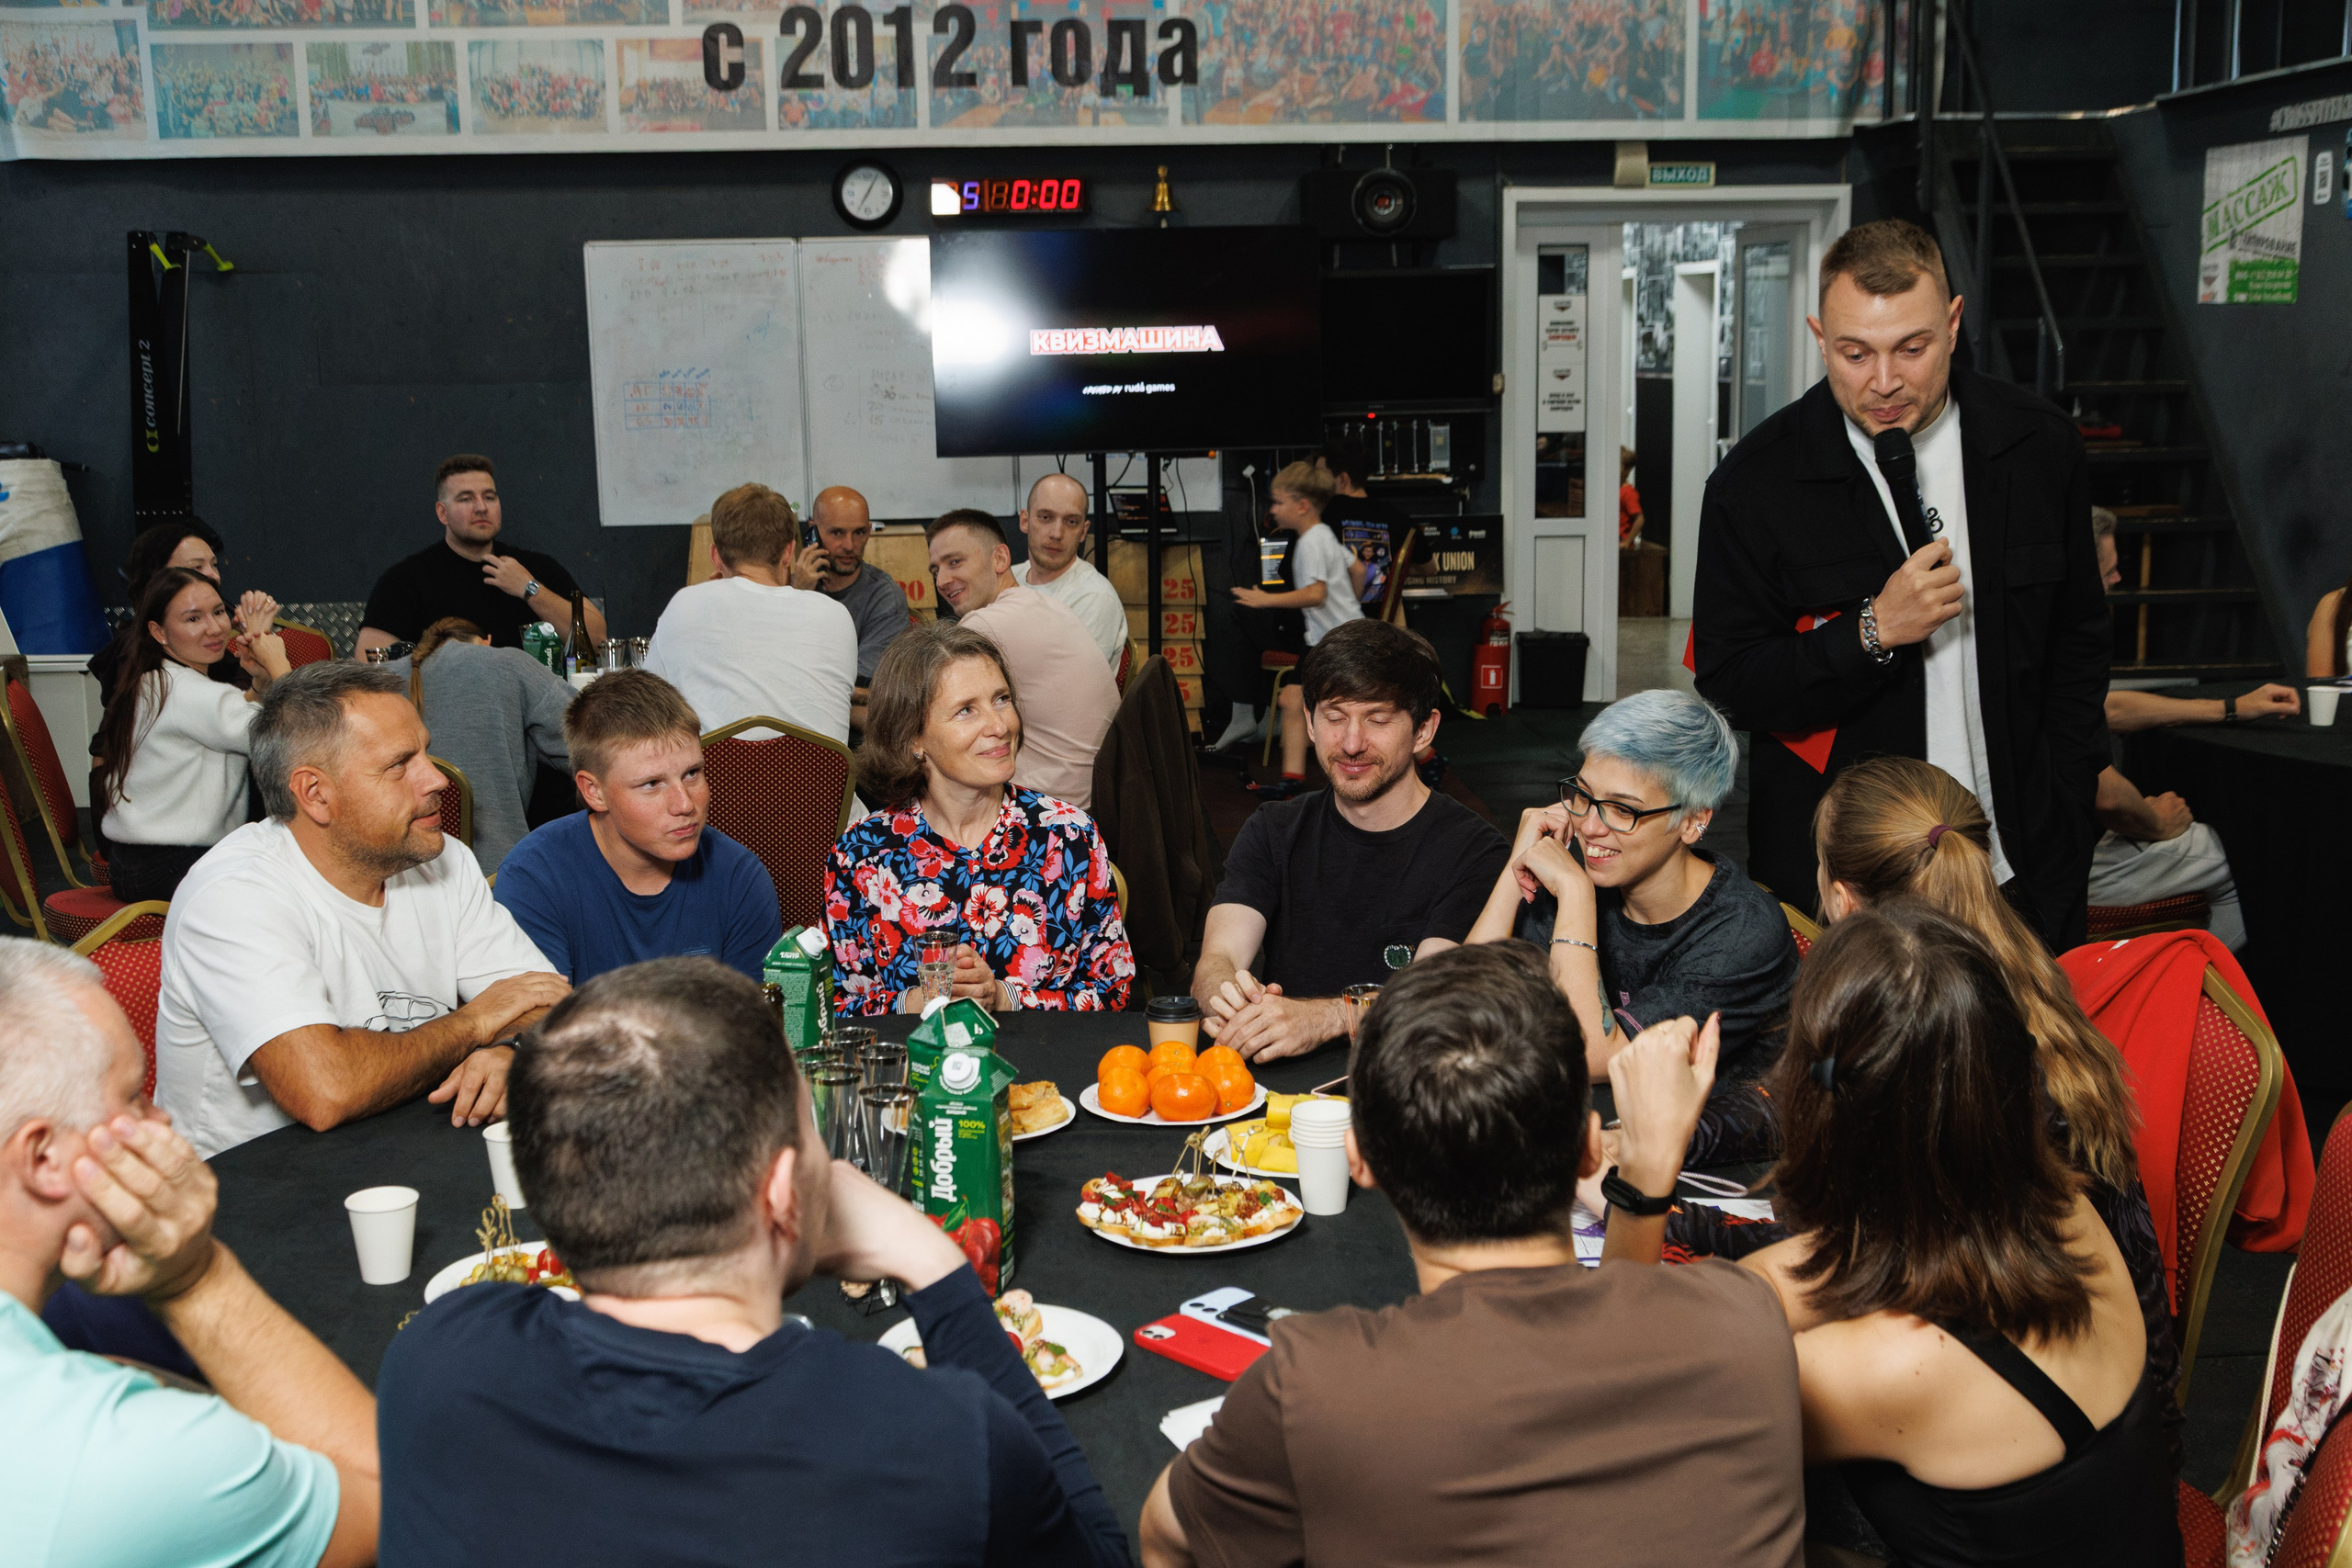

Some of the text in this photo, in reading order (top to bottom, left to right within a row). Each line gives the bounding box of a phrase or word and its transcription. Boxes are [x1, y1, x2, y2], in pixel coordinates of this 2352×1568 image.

[702, 5, 1198, 96] с 2012 года
[1651, 166, 1708, 182] ВЫХОД
[1012, 179, 1080, 209] 0:00
[2207, 170, 2289, 242] МАССАЖ
[1030, 325, 1225, 355] КВИЗМАШИНА
[139, 339, 157, 428] concept 2
[1146, 383, 1175, 394] games
[1442, 551, 1475, 571] UNION
[1163, 579, 1195, 600] 25
[1426, 575, 1457, 584] HISTORY
[1165, 614, 1195, 634] 25
[1162, 647, 1194, 668] 25
[1178, 682, 1191, 702] 5
[957, 1120, 986, 1129] 100%
[928, 1114, 957, 1202] Добрый
